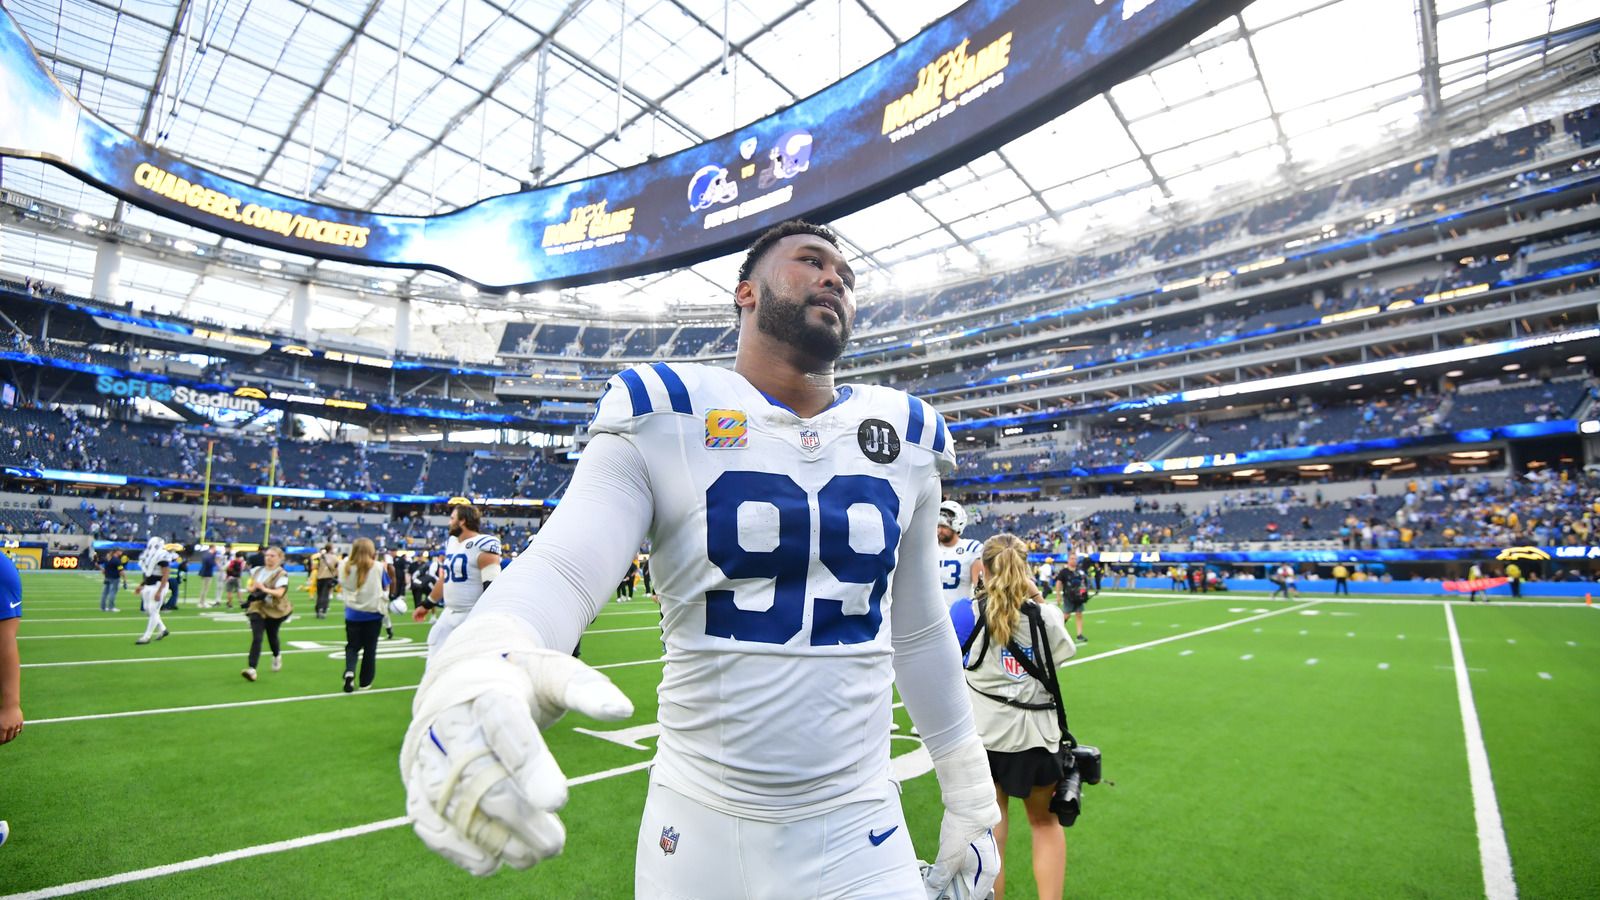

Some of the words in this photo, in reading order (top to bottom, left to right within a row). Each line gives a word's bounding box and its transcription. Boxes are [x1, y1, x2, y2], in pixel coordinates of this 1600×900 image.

[96, 374, 147, 398] SoFi
[173, 385, 260, 413] Stadium
[803, 436, 818, 447] NFL
[53, 556, 79, 568] 0:00
[705, 470, 902, 647] 99
